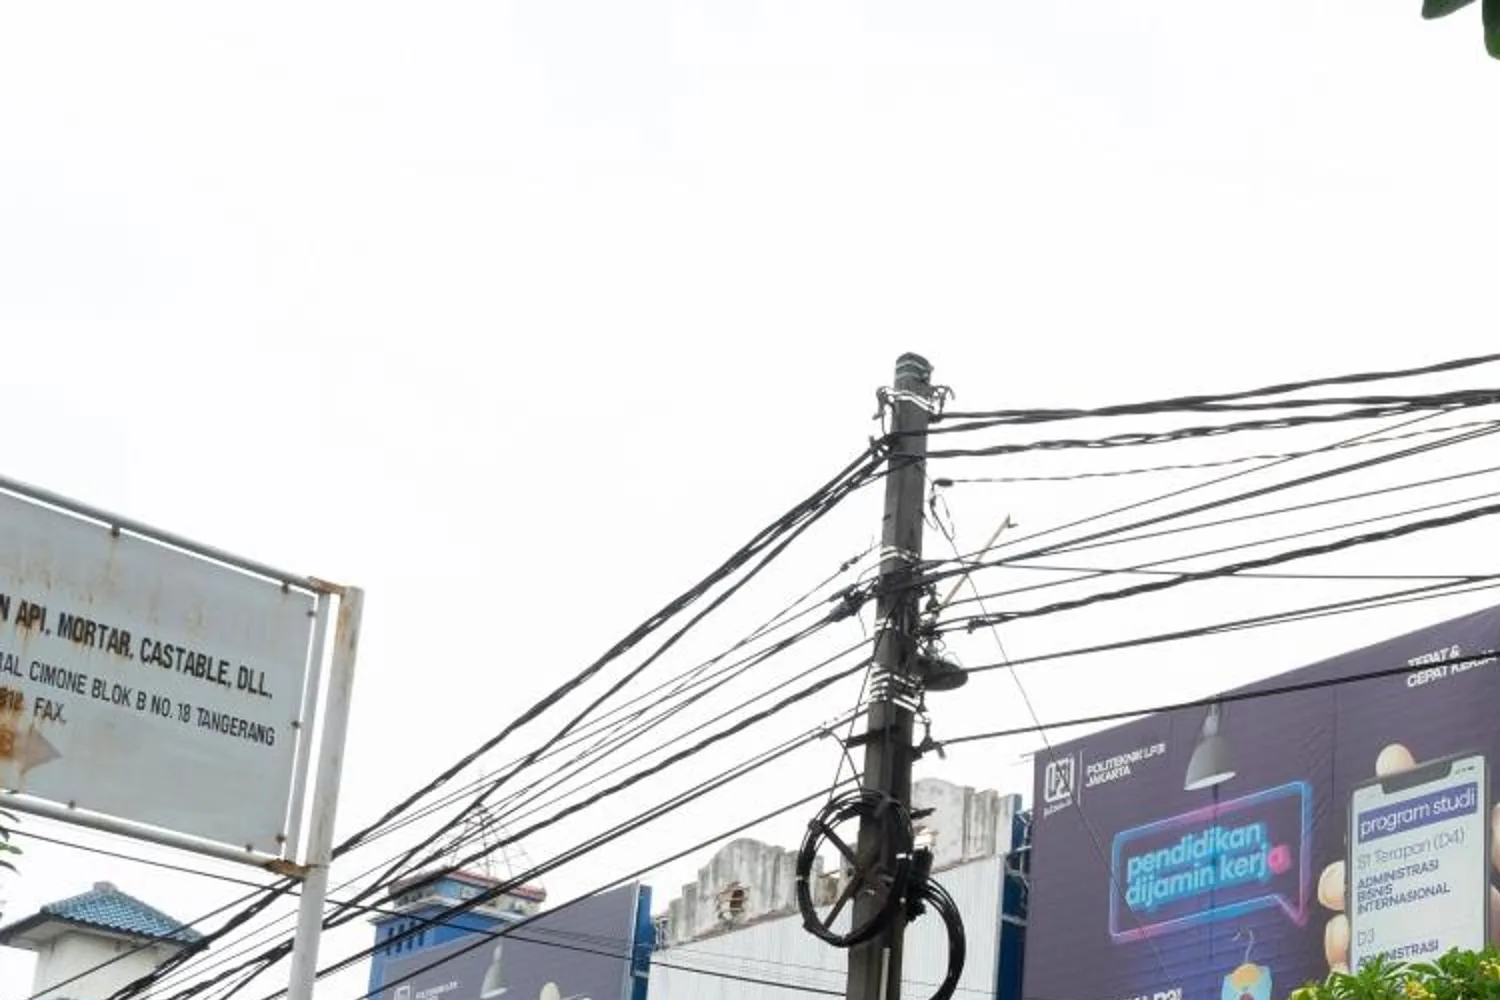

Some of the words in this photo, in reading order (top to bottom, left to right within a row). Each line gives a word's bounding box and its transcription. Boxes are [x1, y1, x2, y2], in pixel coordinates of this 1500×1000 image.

[29, 661, 88, 695] CIMONE
[91, 677, 132, 708] BLOK
[136, 691, 147, 711] B
[197, 707, 275, 747] TANGERANG
[1359, 802, 1432, 840] program
[1433, 786, 1476, 815] studi
[1125, 861, 1215, 907] dijamin
[1219, 842, 1291, 881] kerja
[1127, 822, 1262, 883] pendidikan
[1357, 858, 1440, 889] ADMINISTRASI
[1357, 883, 1393, 903] BISNIS
[1357, 881, 1452, 914] INTERNASIONAL
